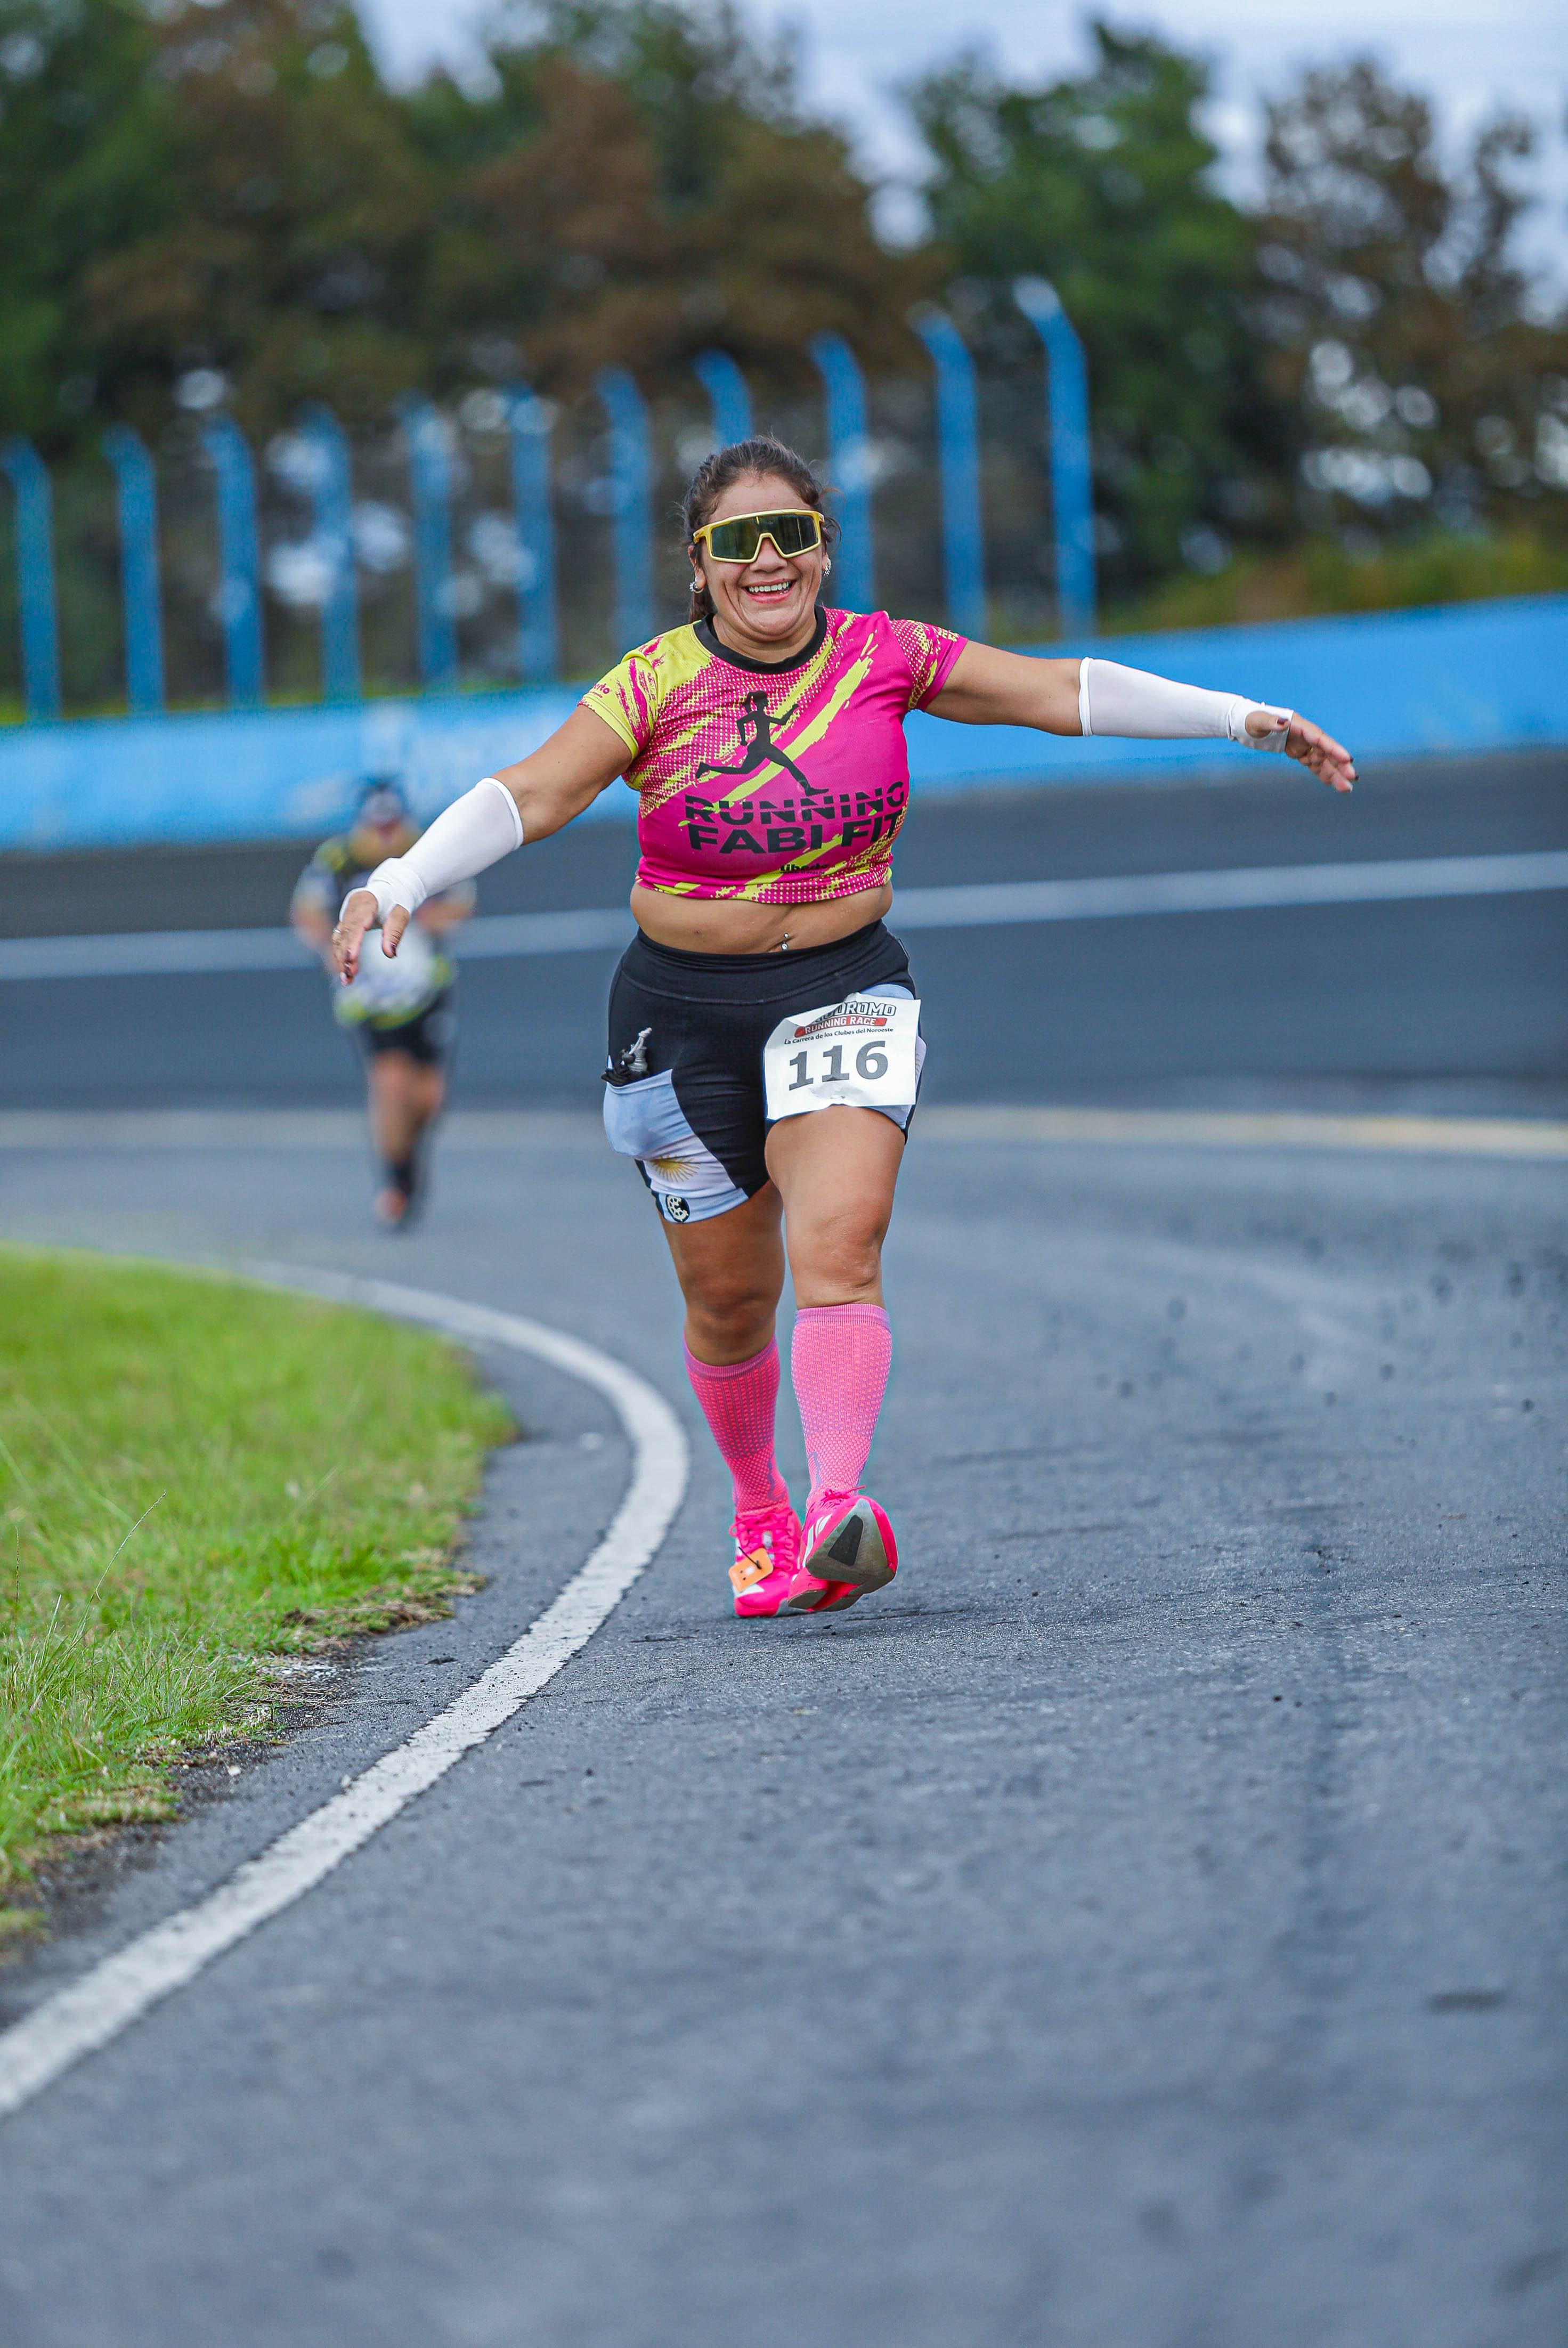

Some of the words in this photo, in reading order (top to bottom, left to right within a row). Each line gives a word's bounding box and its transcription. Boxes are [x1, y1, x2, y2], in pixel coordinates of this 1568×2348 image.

[685, 781, 905, 825] RUNNING
[687, 823, 823, 855] FABI
[841, 811, 903, 847] FIT
[805, 1018, 847, 1034] RUNNING
[849, 1015, 877, 1026] RACE
[789, 1041, 888, 1091] 116
